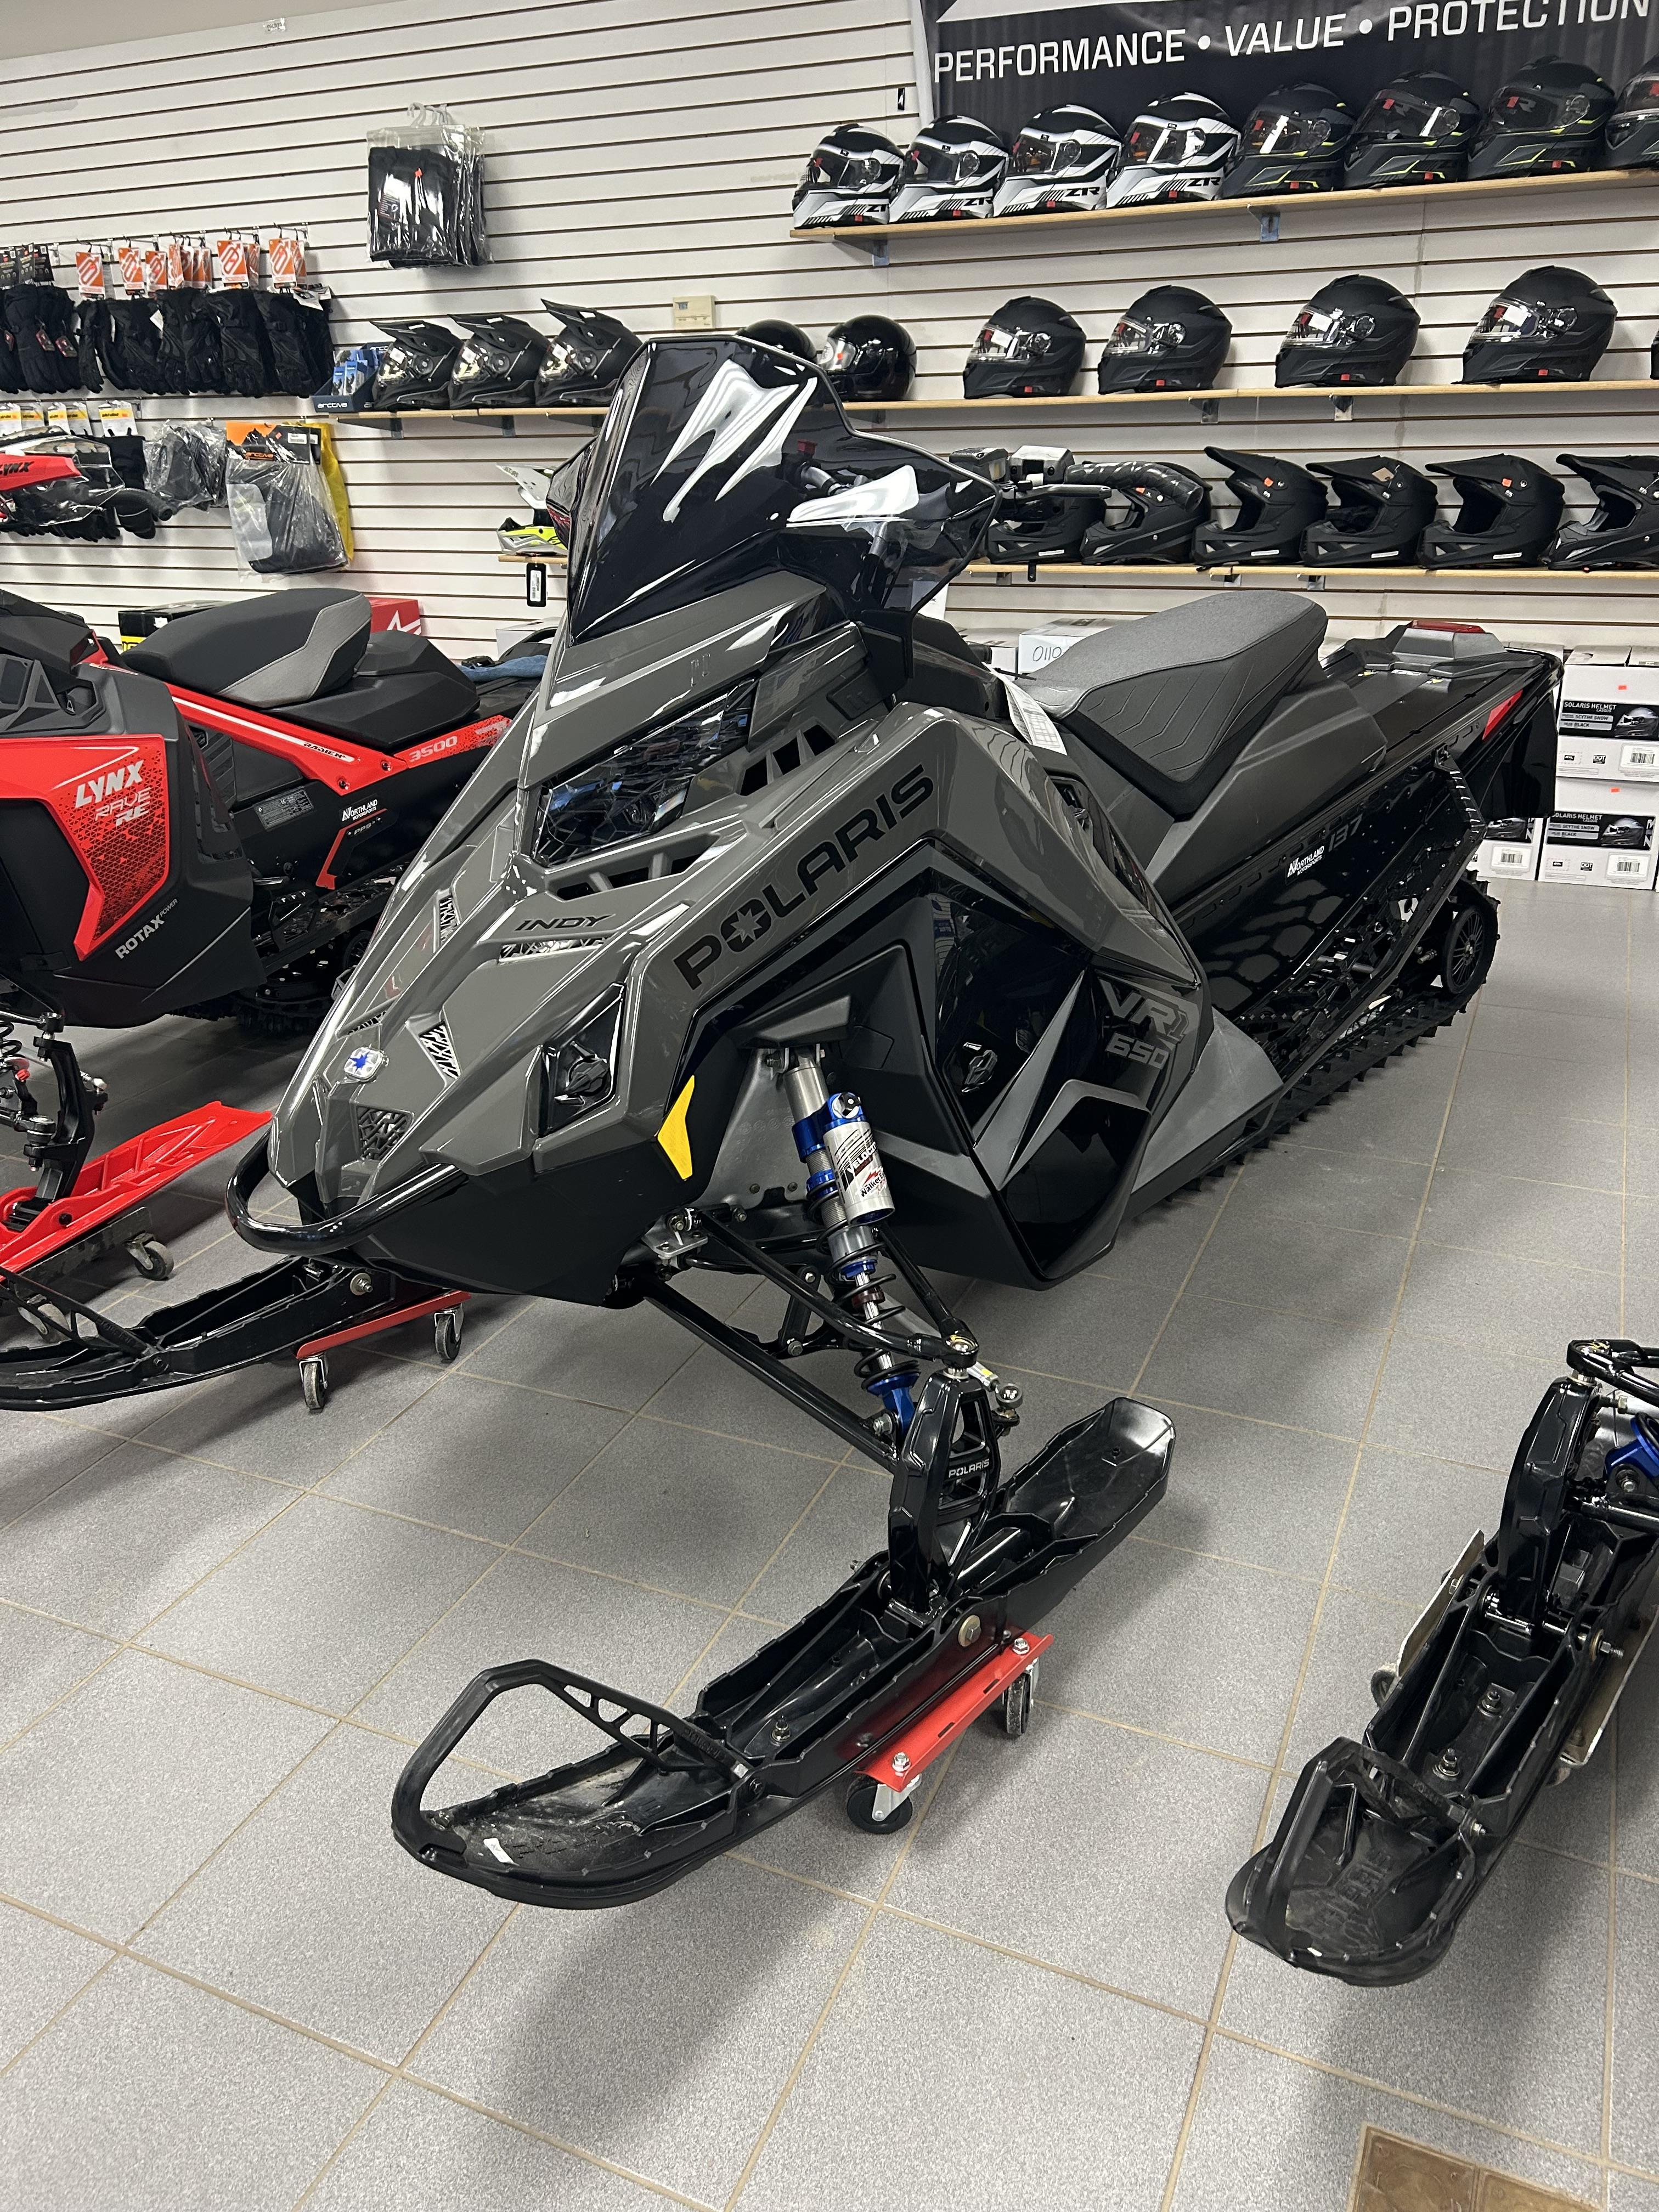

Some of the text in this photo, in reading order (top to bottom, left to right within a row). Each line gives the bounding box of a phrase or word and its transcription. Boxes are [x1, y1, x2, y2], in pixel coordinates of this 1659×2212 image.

[934, 0, 1648, 83] PERFORMANCE VALUE PROTECTION
[1032, 646, 1063, 662] 0110
[409, 736, 458, 763] 3500
[75, 760, 144, 808] LYNX
[95, 787, 151, 821] RAVE
[115, 801, 151, 826] RE
[342, 799, 378, 821] NORTHLAND
[1328, 814, 1363, 852] 137
[673, 764, 933, 990] POLARIS
[1287, 845, 1324, 878] NORTHLAND
[115, 899, 178, 959] ROTAX POWER
[515, 913, 616, 931] INDY
[1105, 1032, 1170, 1070] 650
[948, 1458, 990, 1478] POLARIS
